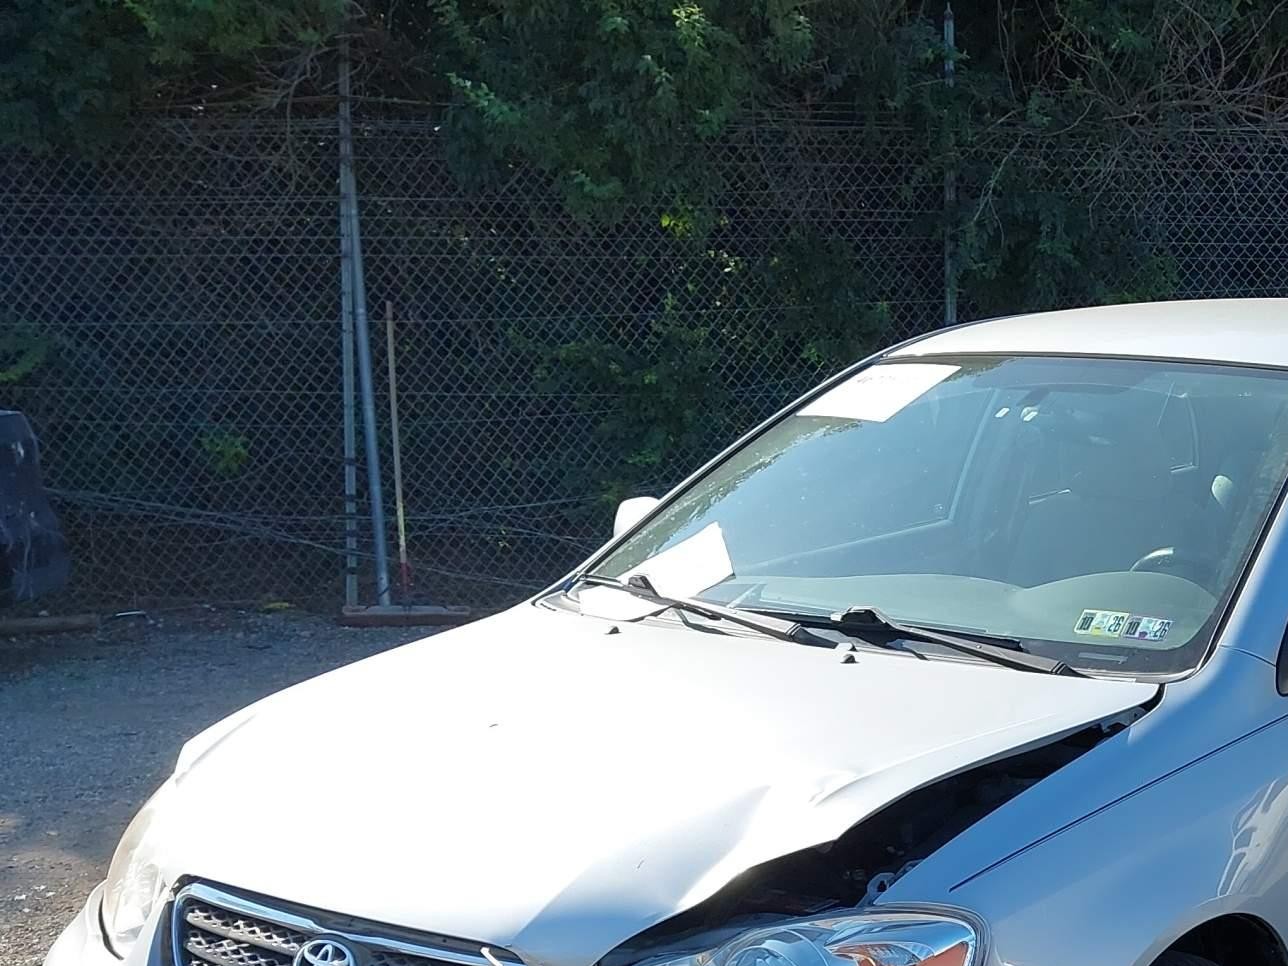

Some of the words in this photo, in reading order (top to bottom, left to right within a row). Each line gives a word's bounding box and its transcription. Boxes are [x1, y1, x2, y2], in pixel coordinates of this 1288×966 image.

[1107, 615, 1125, 633] 26
[1125, 621, 1141, 636] 10
[1152, 620, 1171, 638] 26
